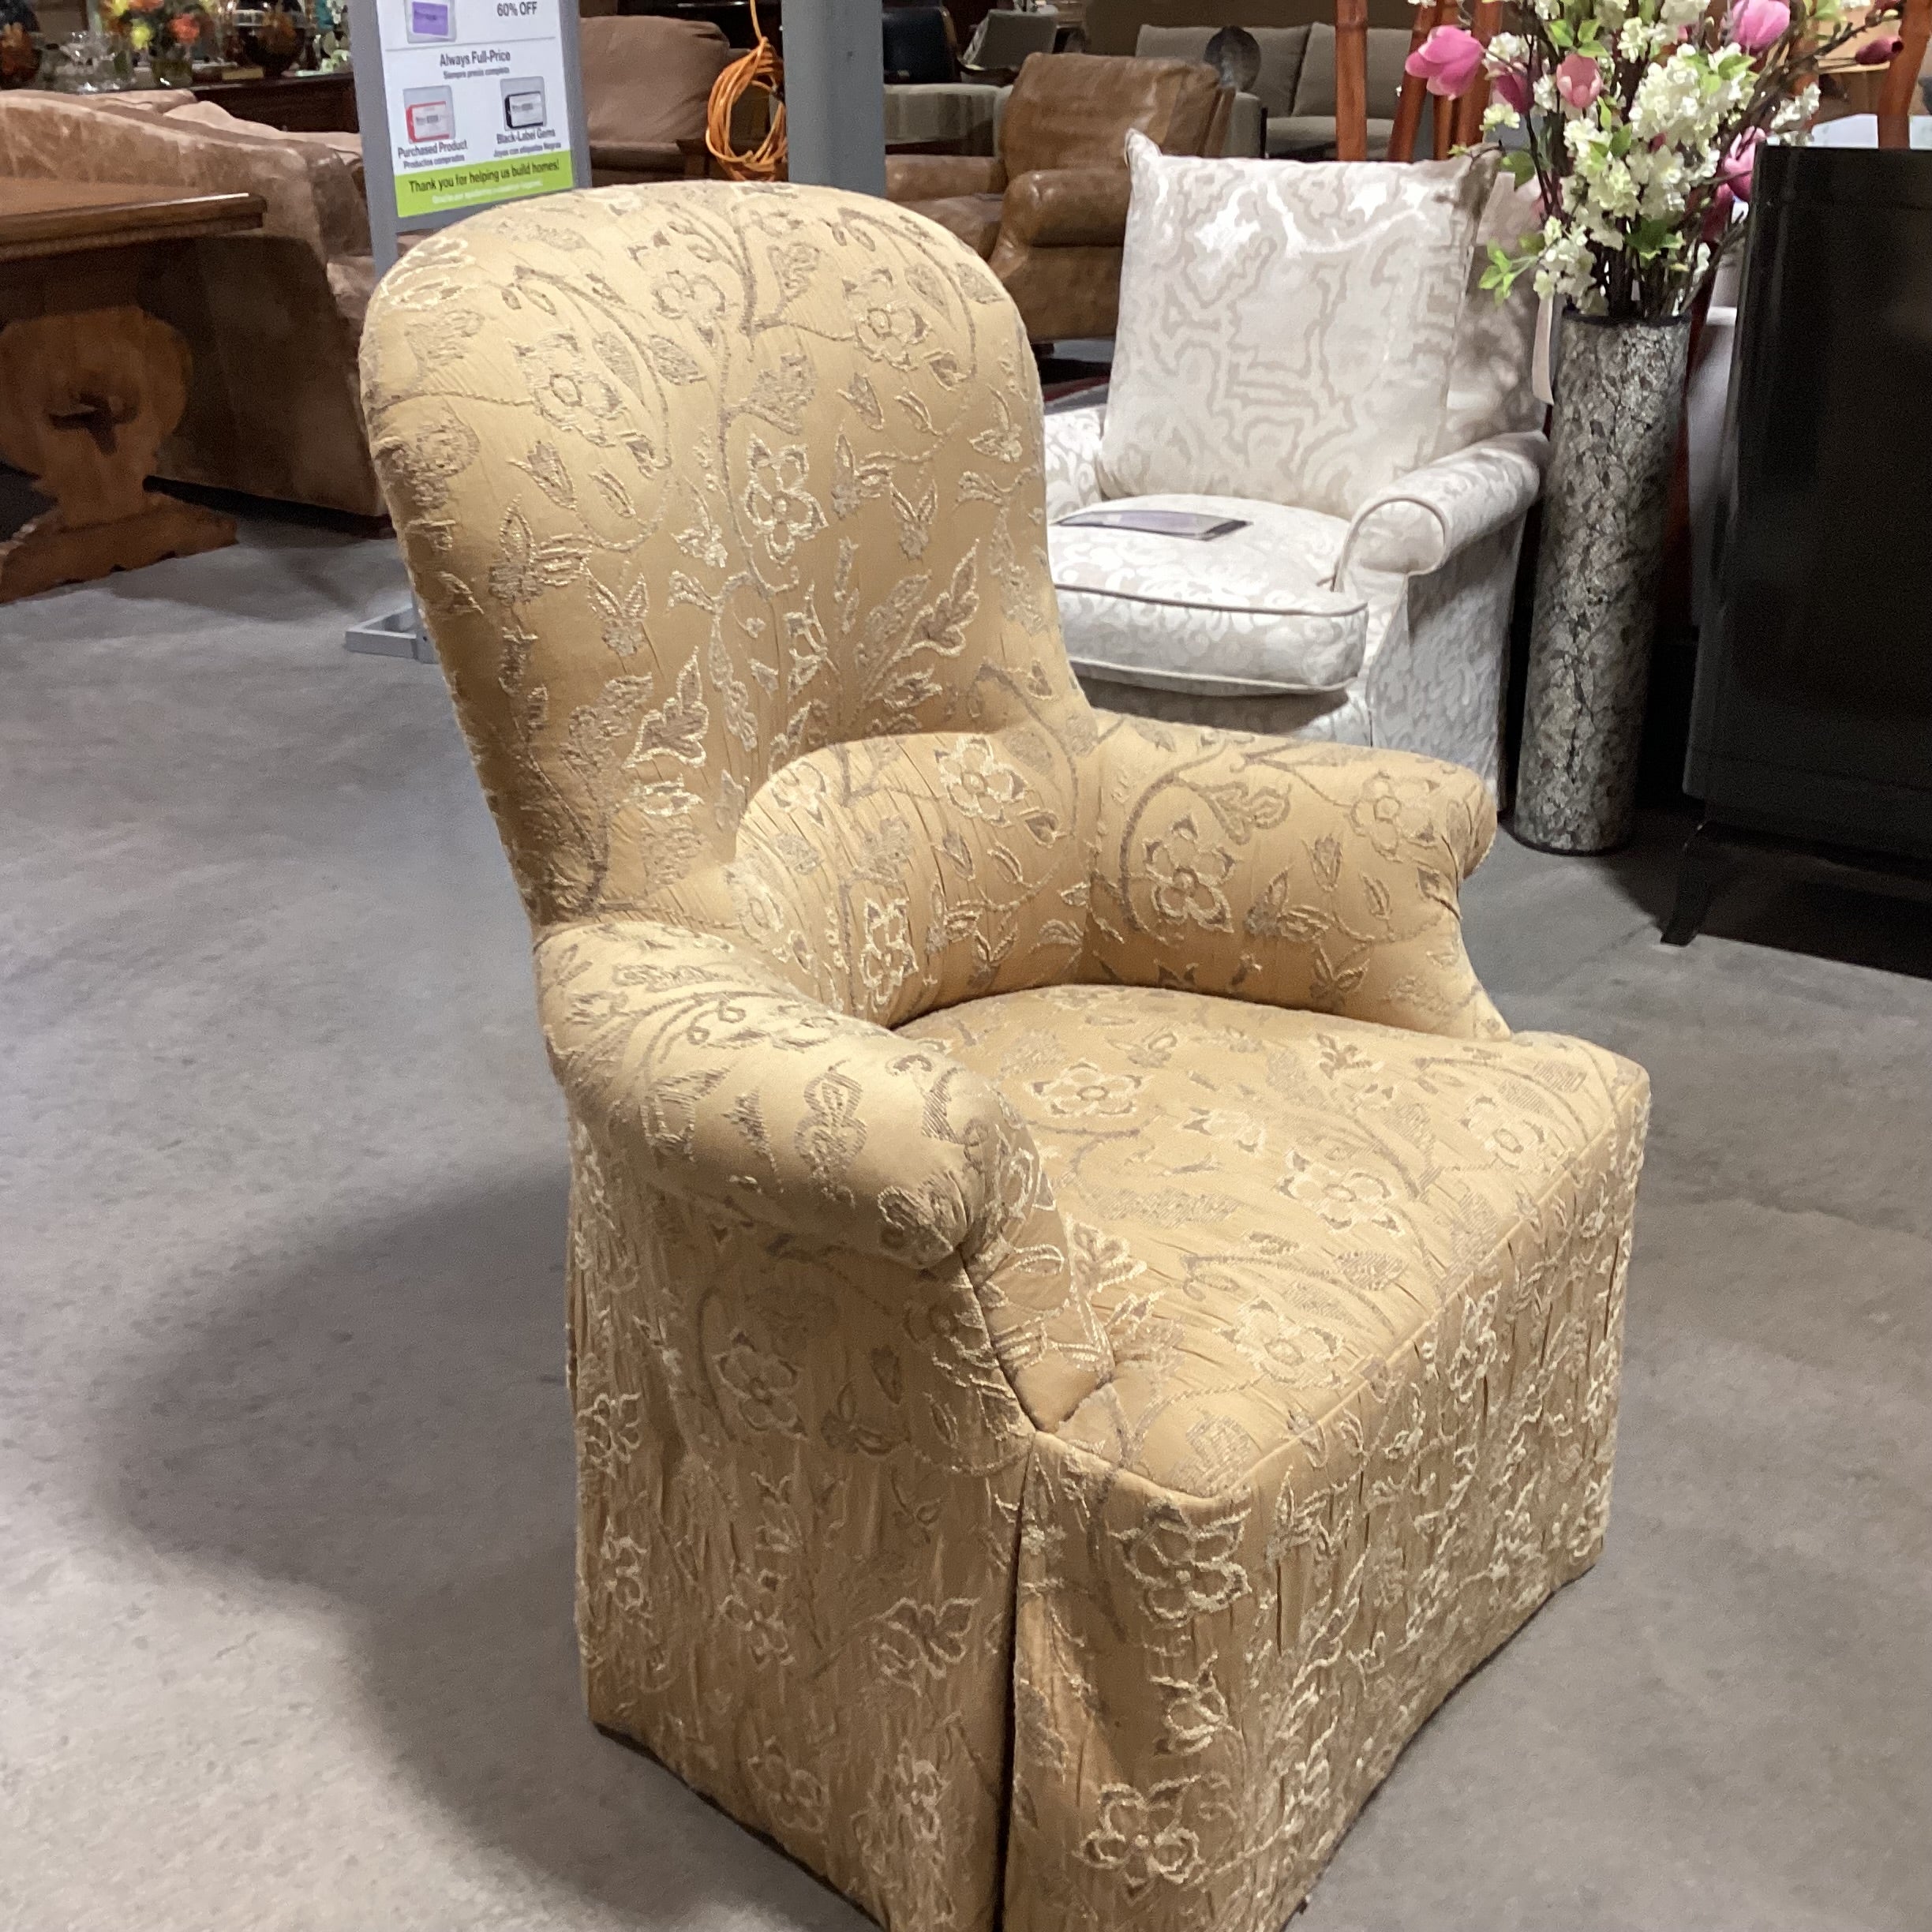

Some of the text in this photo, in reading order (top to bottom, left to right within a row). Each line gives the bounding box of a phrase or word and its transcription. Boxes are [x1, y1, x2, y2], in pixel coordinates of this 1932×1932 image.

[519, 2, 537, 15] OFF
[440, 51, 511, 68] Always Full-Price
[398, 140, 468, 159] Purchased Product
[409, 159, 560, 193] Thank you for helping us build homes!
